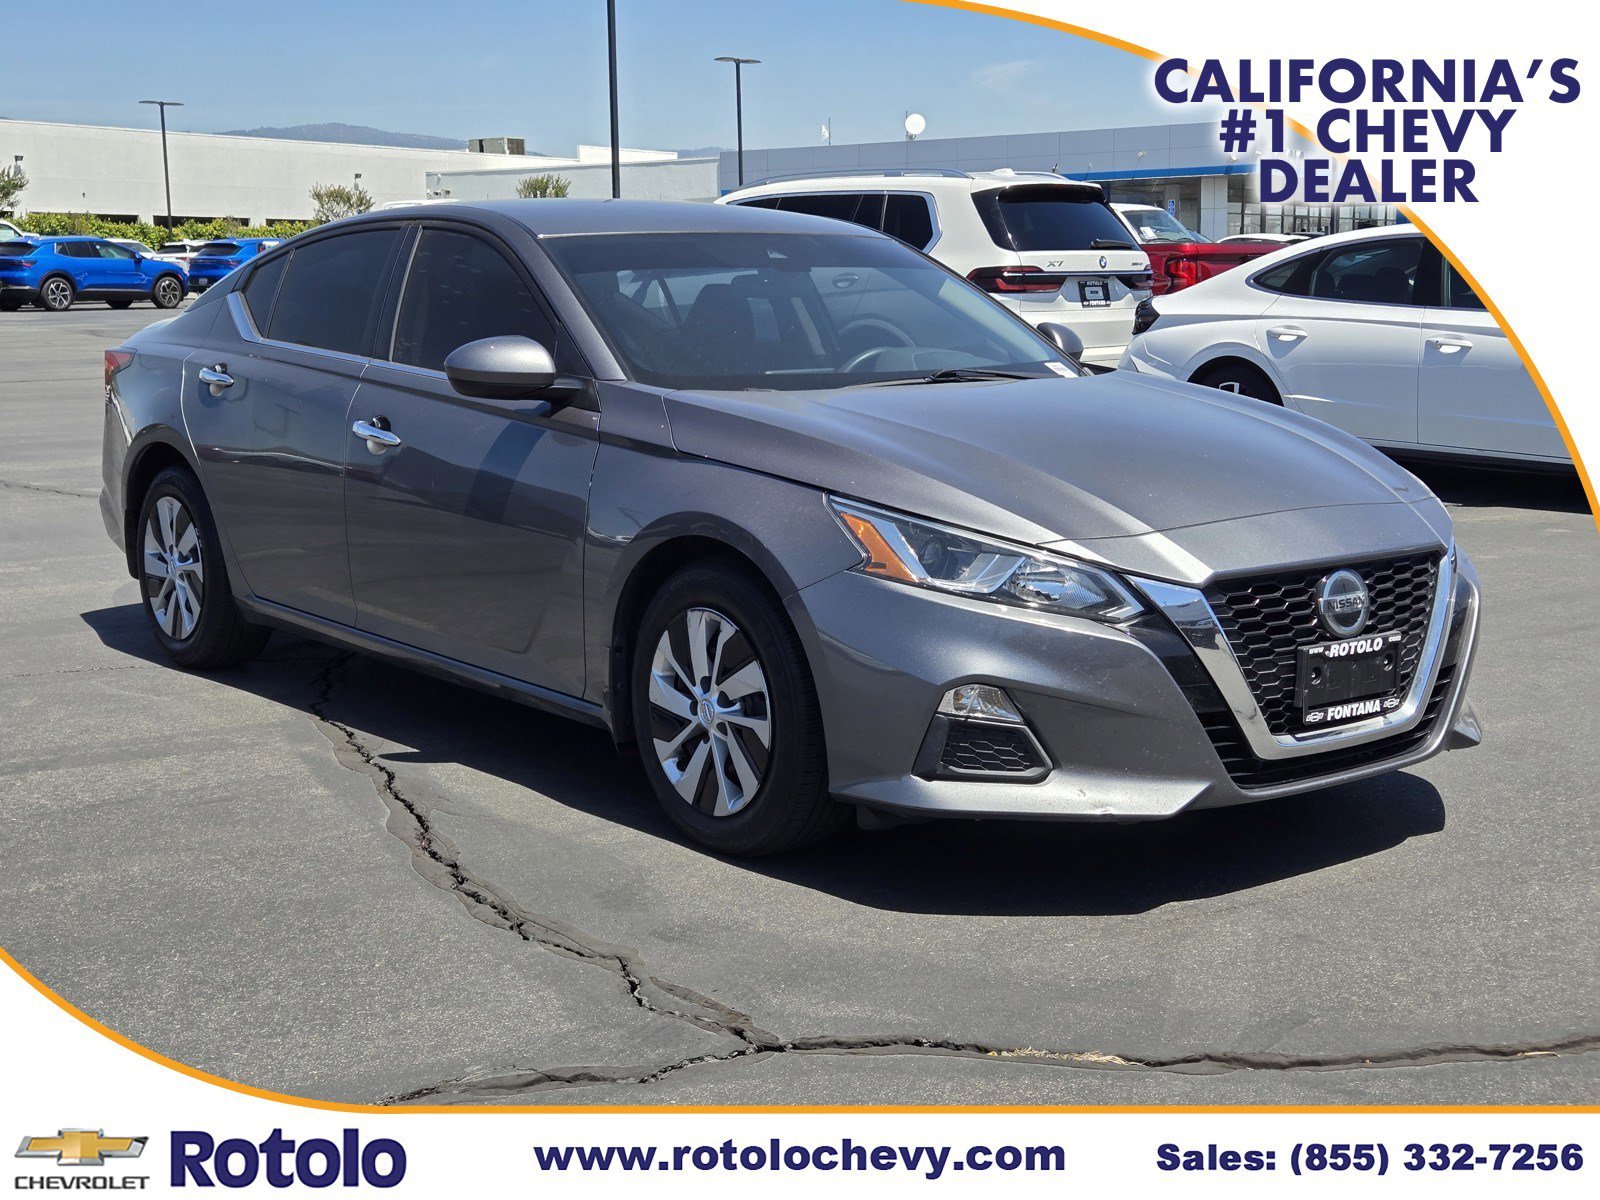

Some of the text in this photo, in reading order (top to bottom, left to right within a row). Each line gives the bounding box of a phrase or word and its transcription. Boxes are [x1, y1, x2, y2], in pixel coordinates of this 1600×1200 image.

[1047, 260, 1064, 268] X7
[1327, 594, 1366, 611] NISSAN
[1326, 699, 1381, 721] FONTANA
